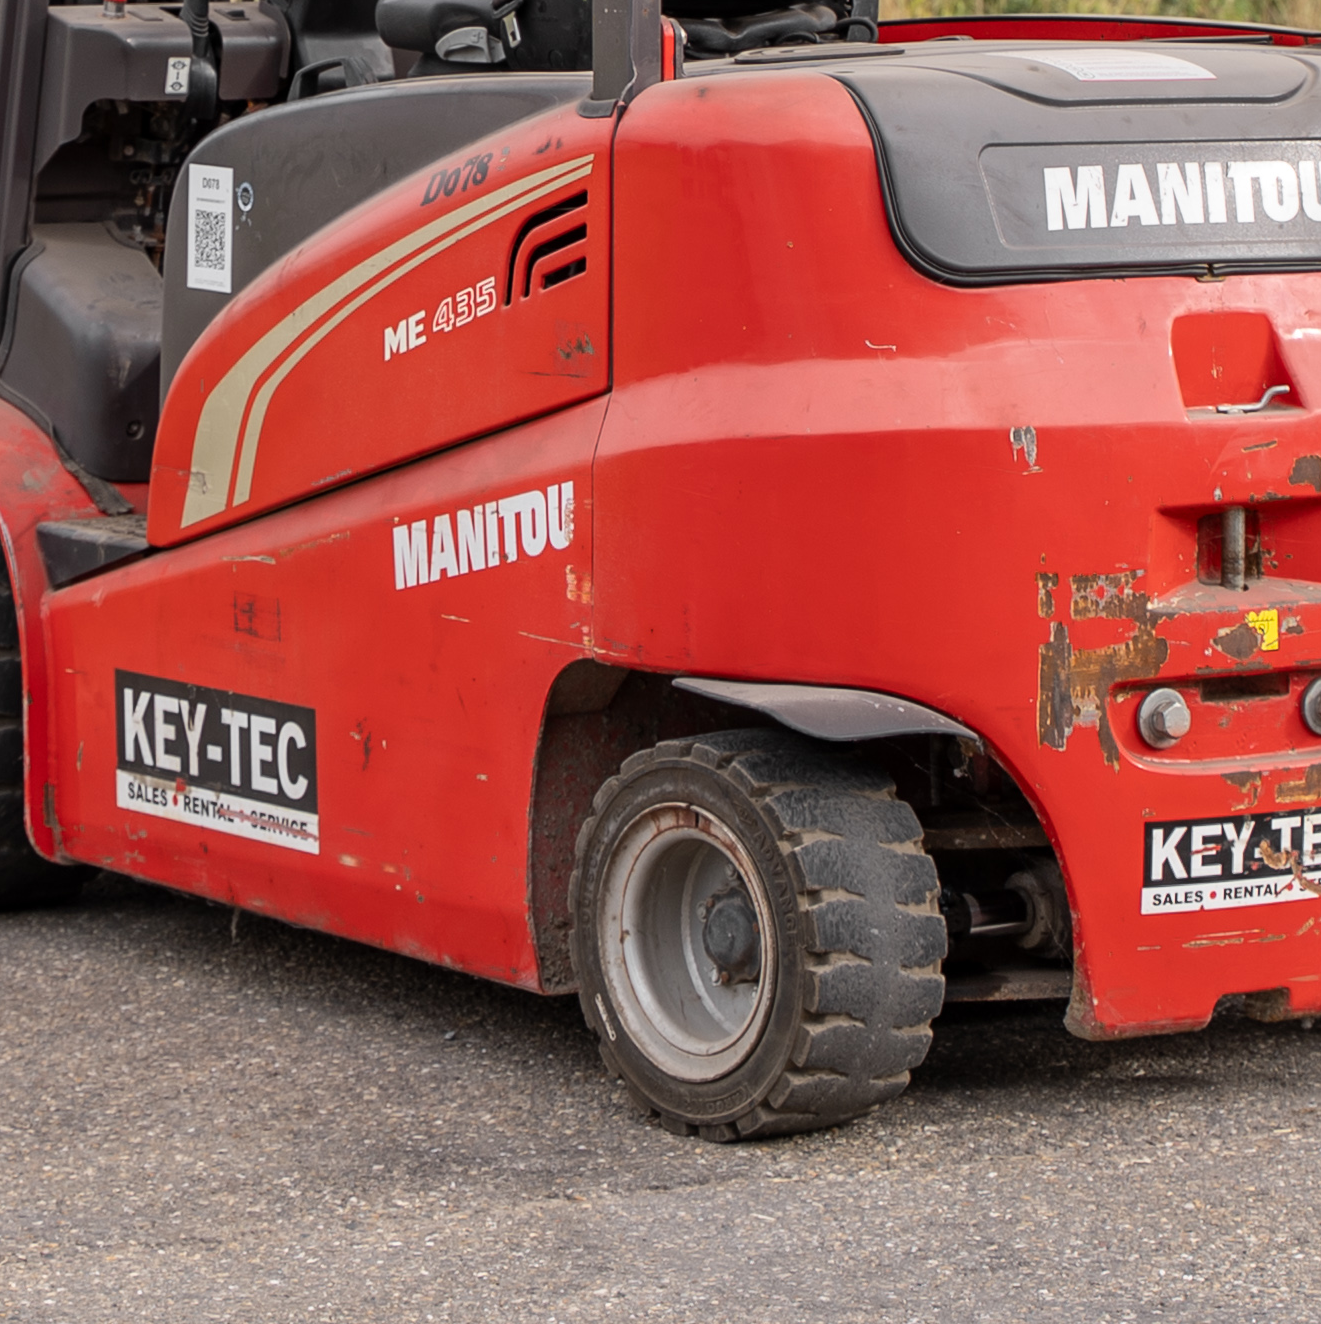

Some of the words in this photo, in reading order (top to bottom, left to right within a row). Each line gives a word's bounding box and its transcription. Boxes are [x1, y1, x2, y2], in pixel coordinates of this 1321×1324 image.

[202, 177, 220, 190] D078
[384, 310, 427, 362] ME
[432, 276, 497, 333] 435
[392, 480, 575, 591] MANITOU
[123, 687, 309, 800] KEY-TEC
[128, 782, 168, 807] SALES
[184, 794, 234, 823] RENTAL
[1152, 890, 1204, 907] SALES
[1223, 883, 1278, 900] RENTAL
